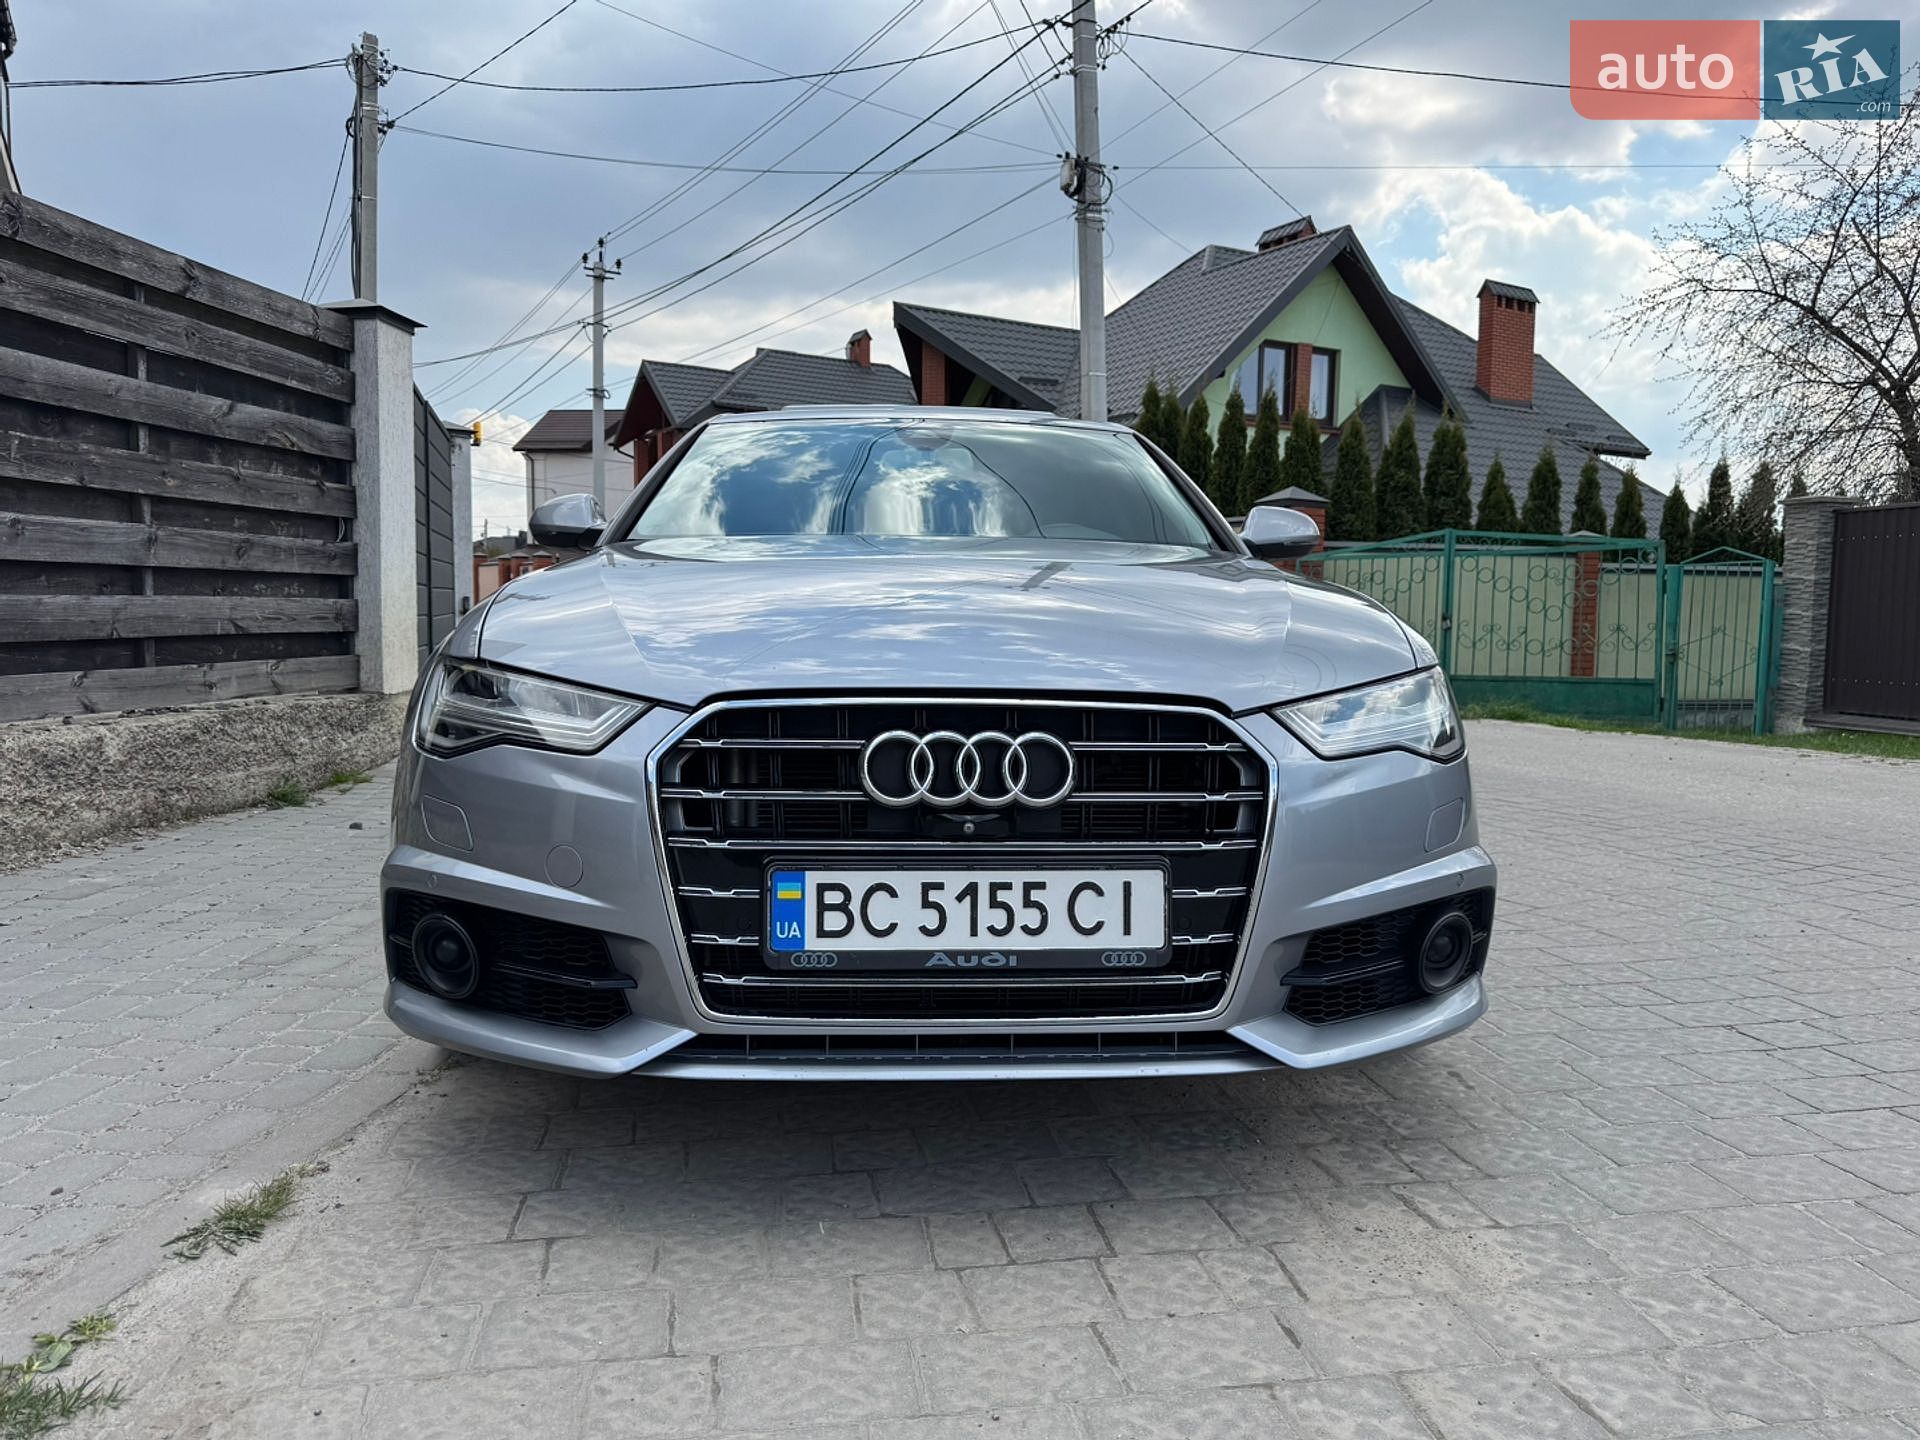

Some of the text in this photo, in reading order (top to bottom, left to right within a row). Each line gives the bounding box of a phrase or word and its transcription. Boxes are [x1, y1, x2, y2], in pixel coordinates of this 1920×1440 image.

[815, 880, 1132, 938] BC 5155 CI
[776, 921, 801, 939] UA
